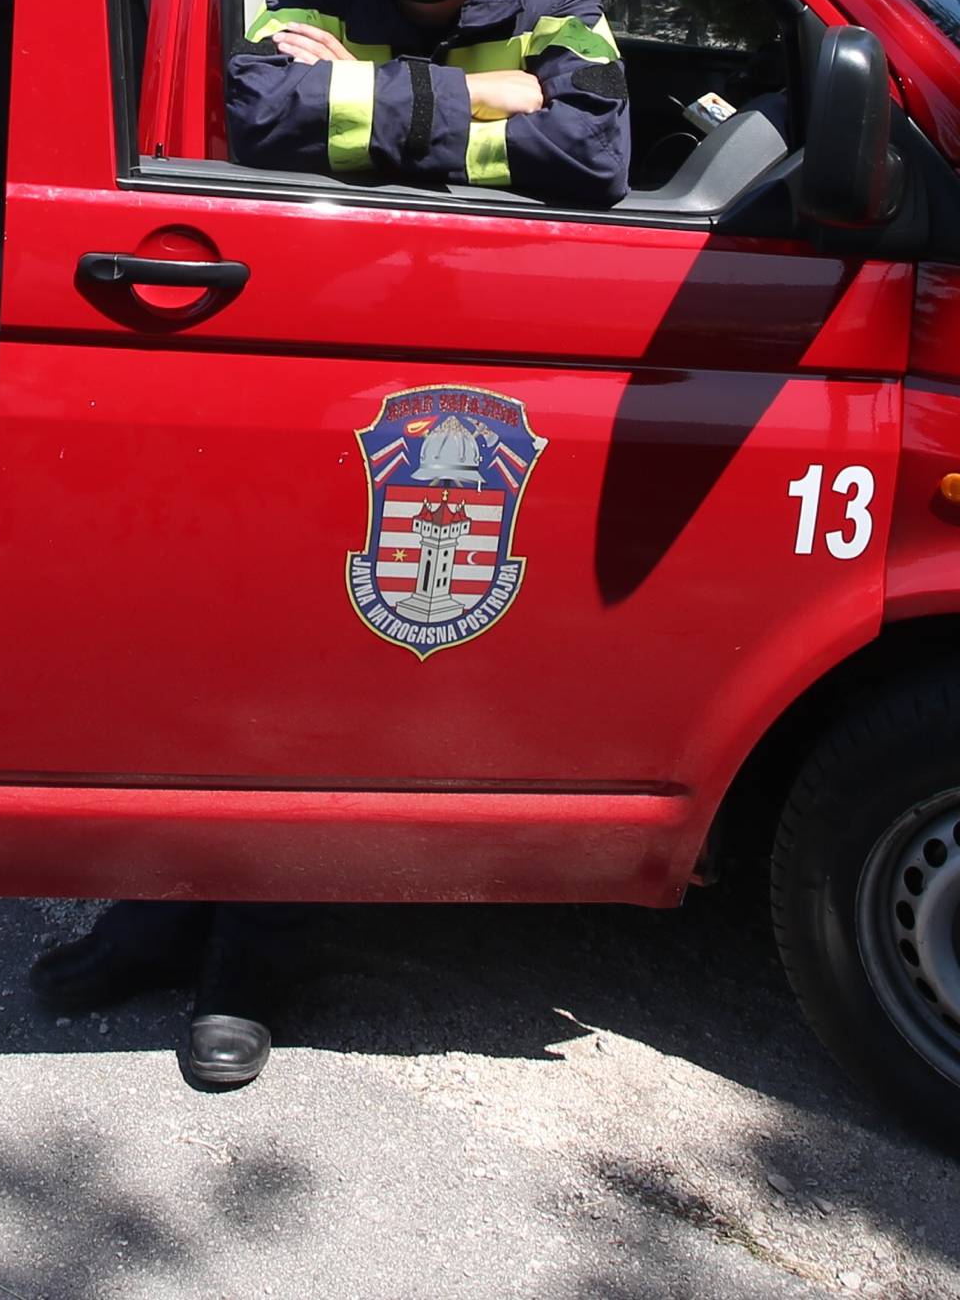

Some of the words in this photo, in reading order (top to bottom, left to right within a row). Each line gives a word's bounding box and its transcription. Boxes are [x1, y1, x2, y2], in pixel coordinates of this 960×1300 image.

[788, 464, 875, 560] 13
[352, 556, 373, 607] JAVNA
[367, 603, 458, 645] VATROGASNA
[458, 563, 519, 636] POSTROJBA
